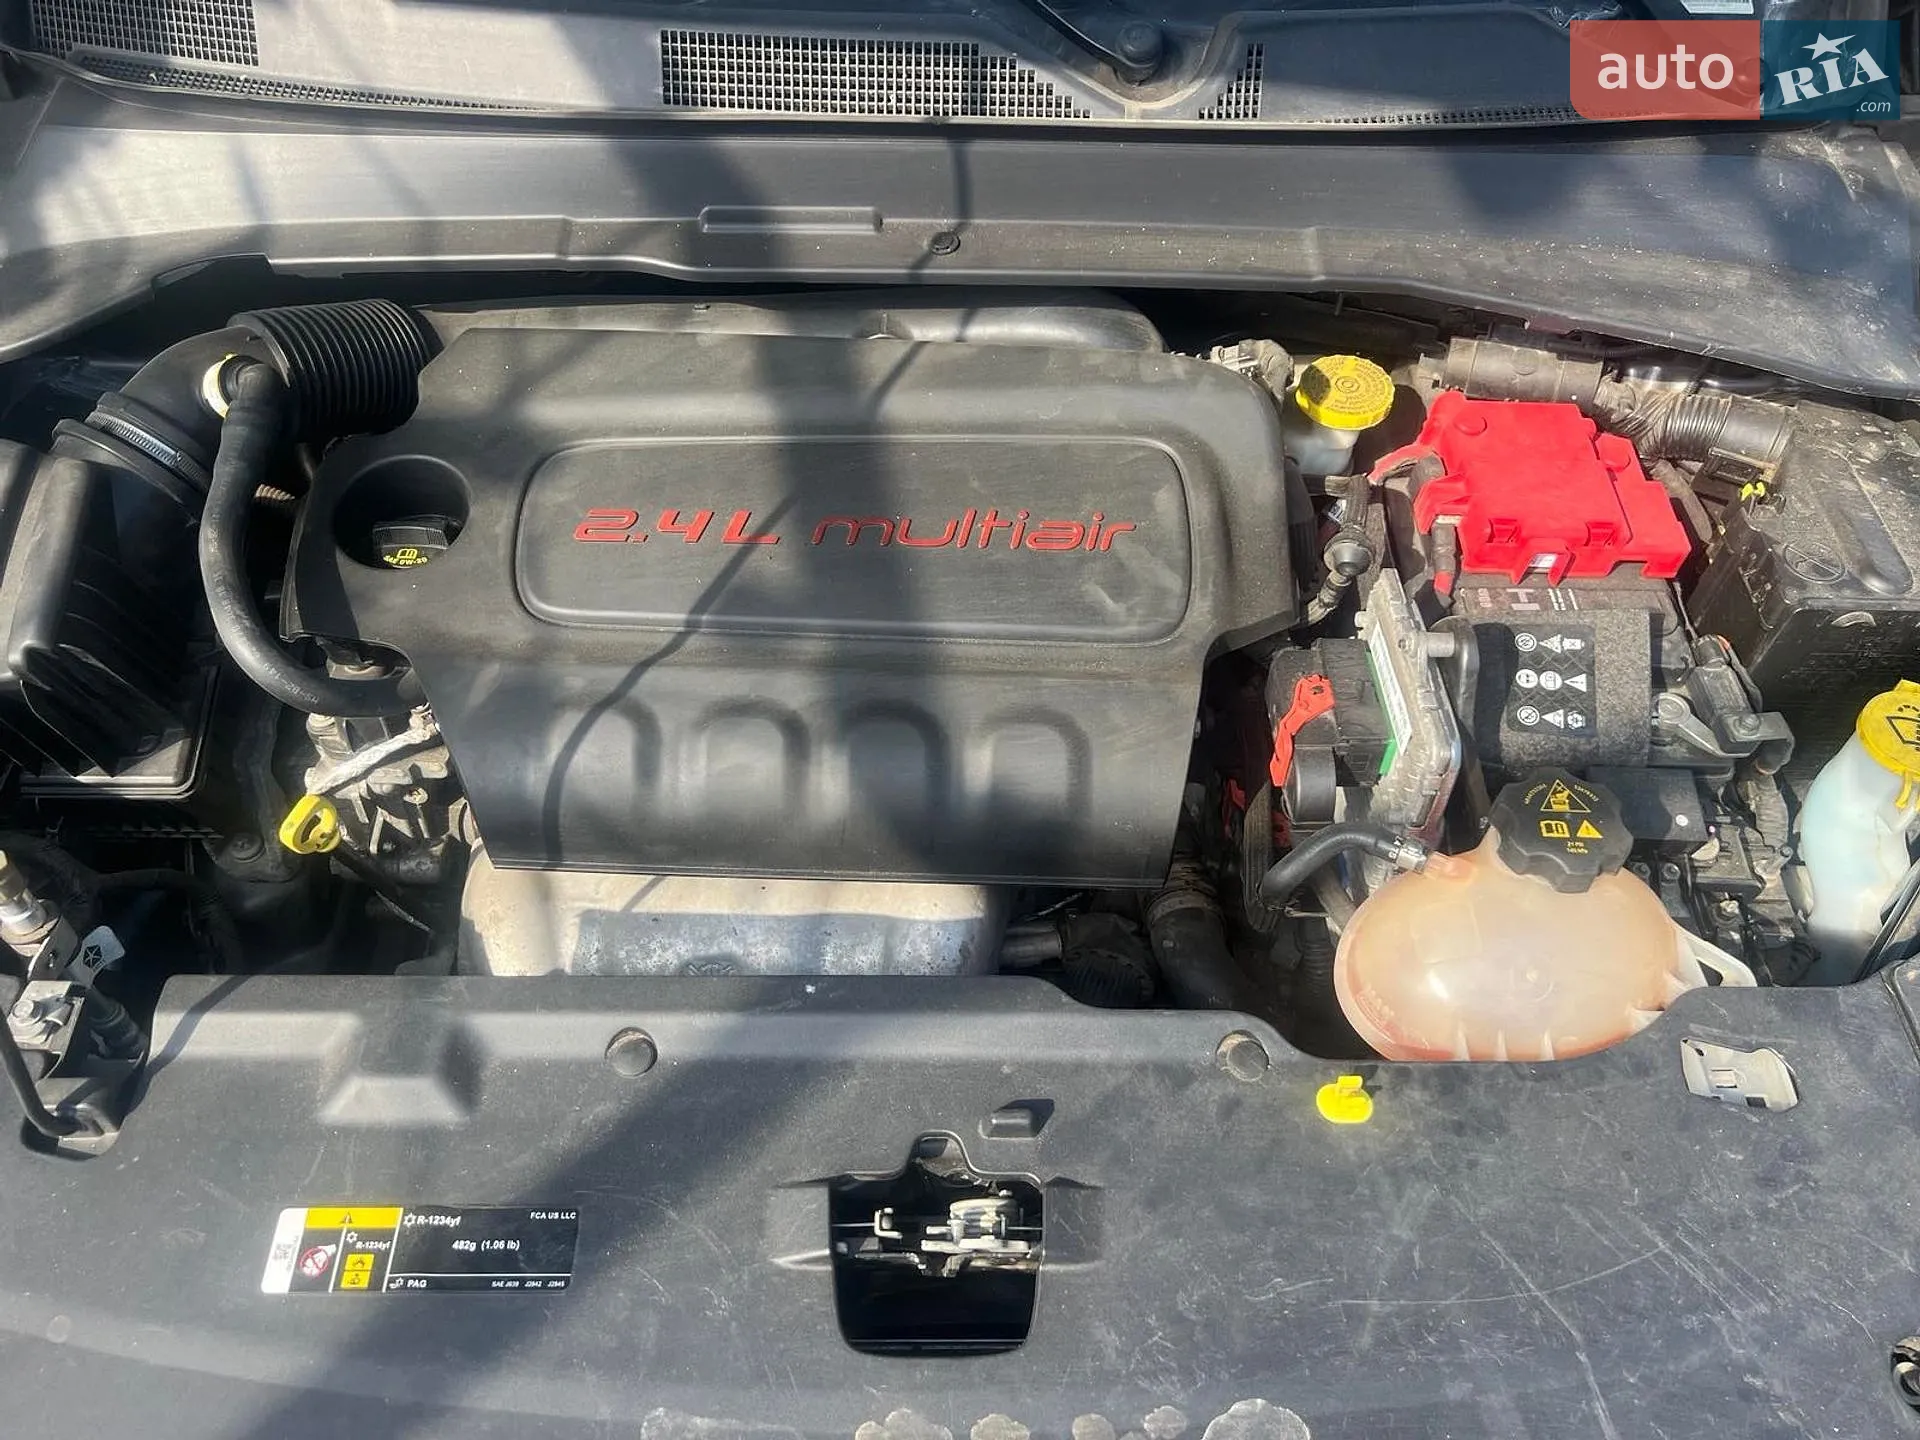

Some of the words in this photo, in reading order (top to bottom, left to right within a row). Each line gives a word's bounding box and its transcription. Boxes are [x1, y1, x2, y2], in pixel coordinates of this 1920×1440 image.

[574, 507, 781, 545] 2.4L
[811, 507, 1136, 551] multiair
[530, 1212, 547, 1220] FCA
[548, 1212, 559, 1220] US
[560, 1212, 577, 1220] LLC
[416, 1215, 462, 1228] R-1234yf
[452, 1240, 477, 1252] 482g
[480, 1240, 505, 1252] (1.06
[506, 1240, 520, 1251] lb)
[407, 1279, 427, 1288] PAG
[491, 1280, 504, 1288] SAE
